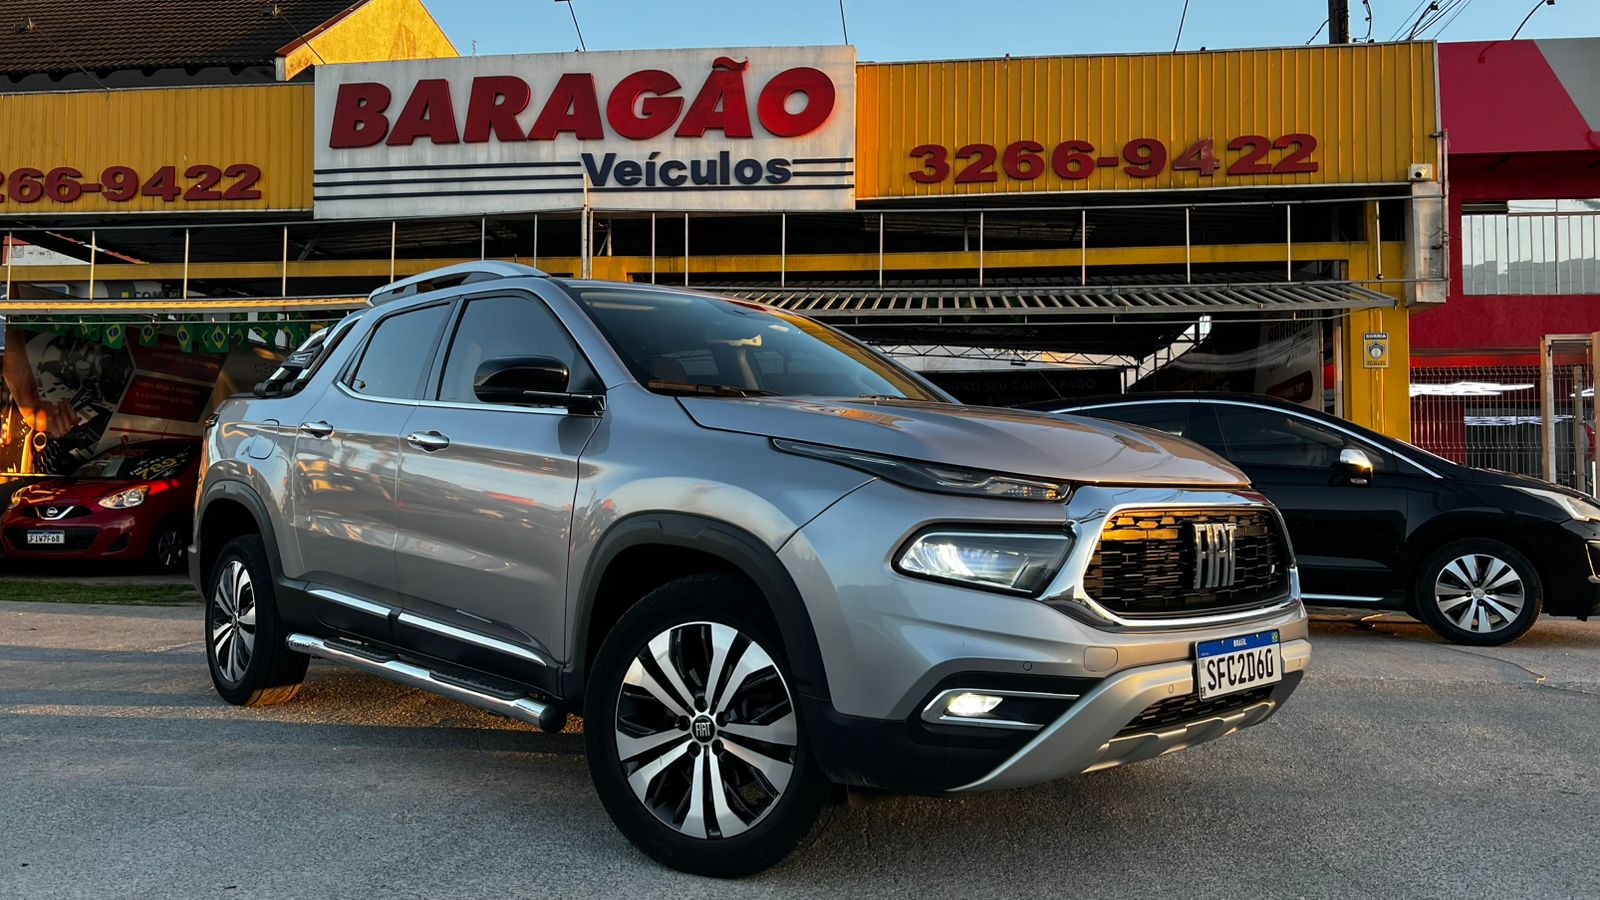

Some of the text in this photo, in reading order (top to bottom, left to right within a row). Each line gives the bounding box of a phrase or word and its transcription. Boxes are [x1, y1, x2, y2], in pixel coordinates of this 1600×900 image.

[329, 56, 836, 149] BARAGÃO
[581, 151, 793, 187] Veículos
[909, 133, 1319, 185] 3266-9422
[0, 163, 262, 203] 66-9422
[1193, 523, 1237, 589] FIAT
[1207, 647, 1275, 691] SFC2D60
[695, 721, 711, 737] FIAT
